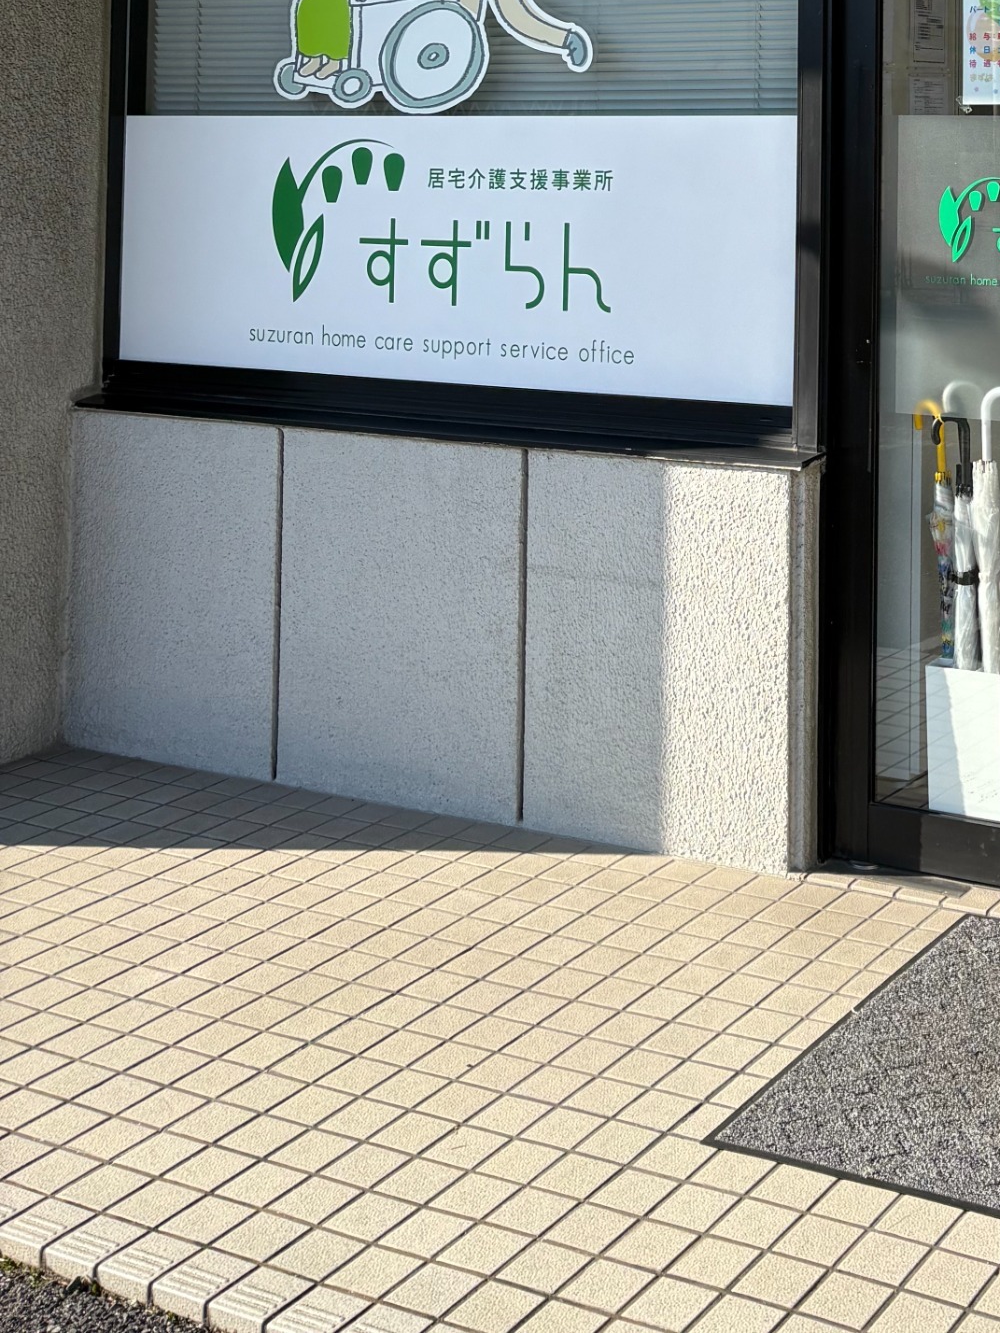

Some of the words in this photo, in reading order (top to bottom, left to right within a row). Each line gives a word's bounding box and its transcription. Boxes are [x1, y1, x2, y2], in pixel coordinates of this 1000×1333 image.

[427, 167, 614, 192] 居宅介護支援事業所
[358, 217, 612, 313] すずらん
[970, 273, 998, 287] home
[249, 327, 314, 346] suzuran
[321, 324, 367, 349] home
[374, 335, 414, 352] care
[422, 338, 492, 360] support
[500, 342, 569, 362] service
[578, 340, 636, 365] office
